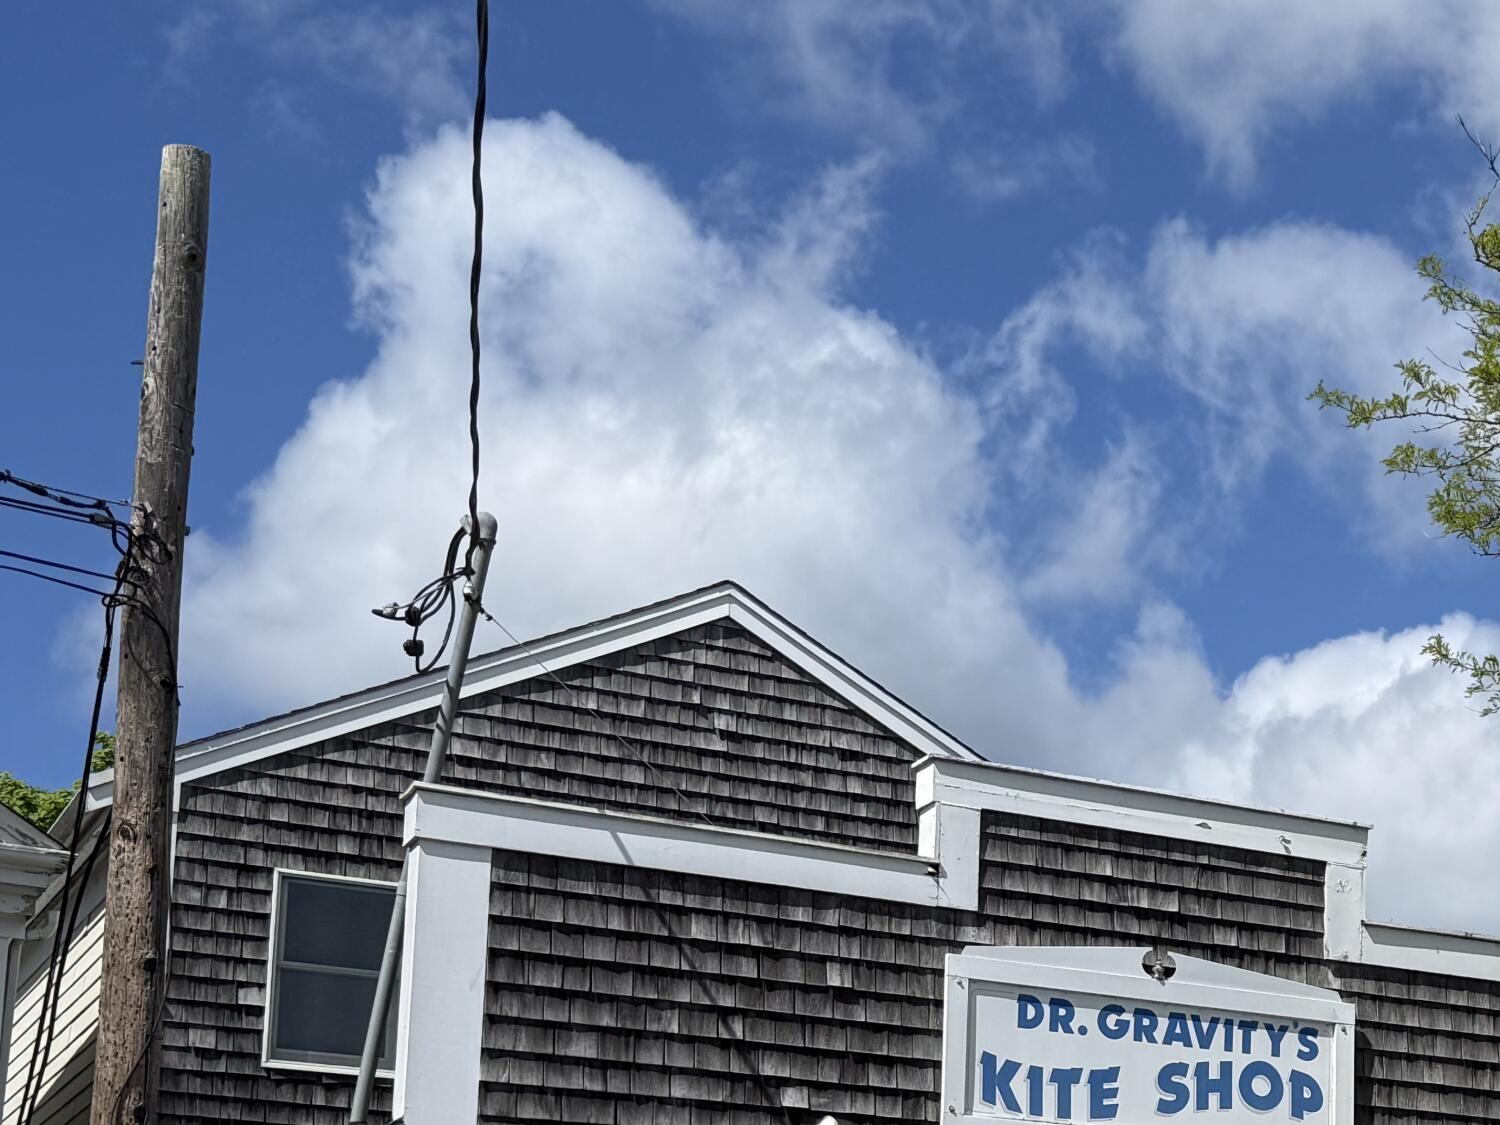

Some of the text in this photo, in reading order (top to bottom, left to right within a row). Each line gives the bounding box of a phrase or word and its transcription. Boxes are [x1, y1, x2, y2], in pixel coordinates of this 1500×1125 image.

[1017, 993, 1319, 1062] DR. GRAVITY'S
[980, 1051, 1324, 1121] KITE SHOP
